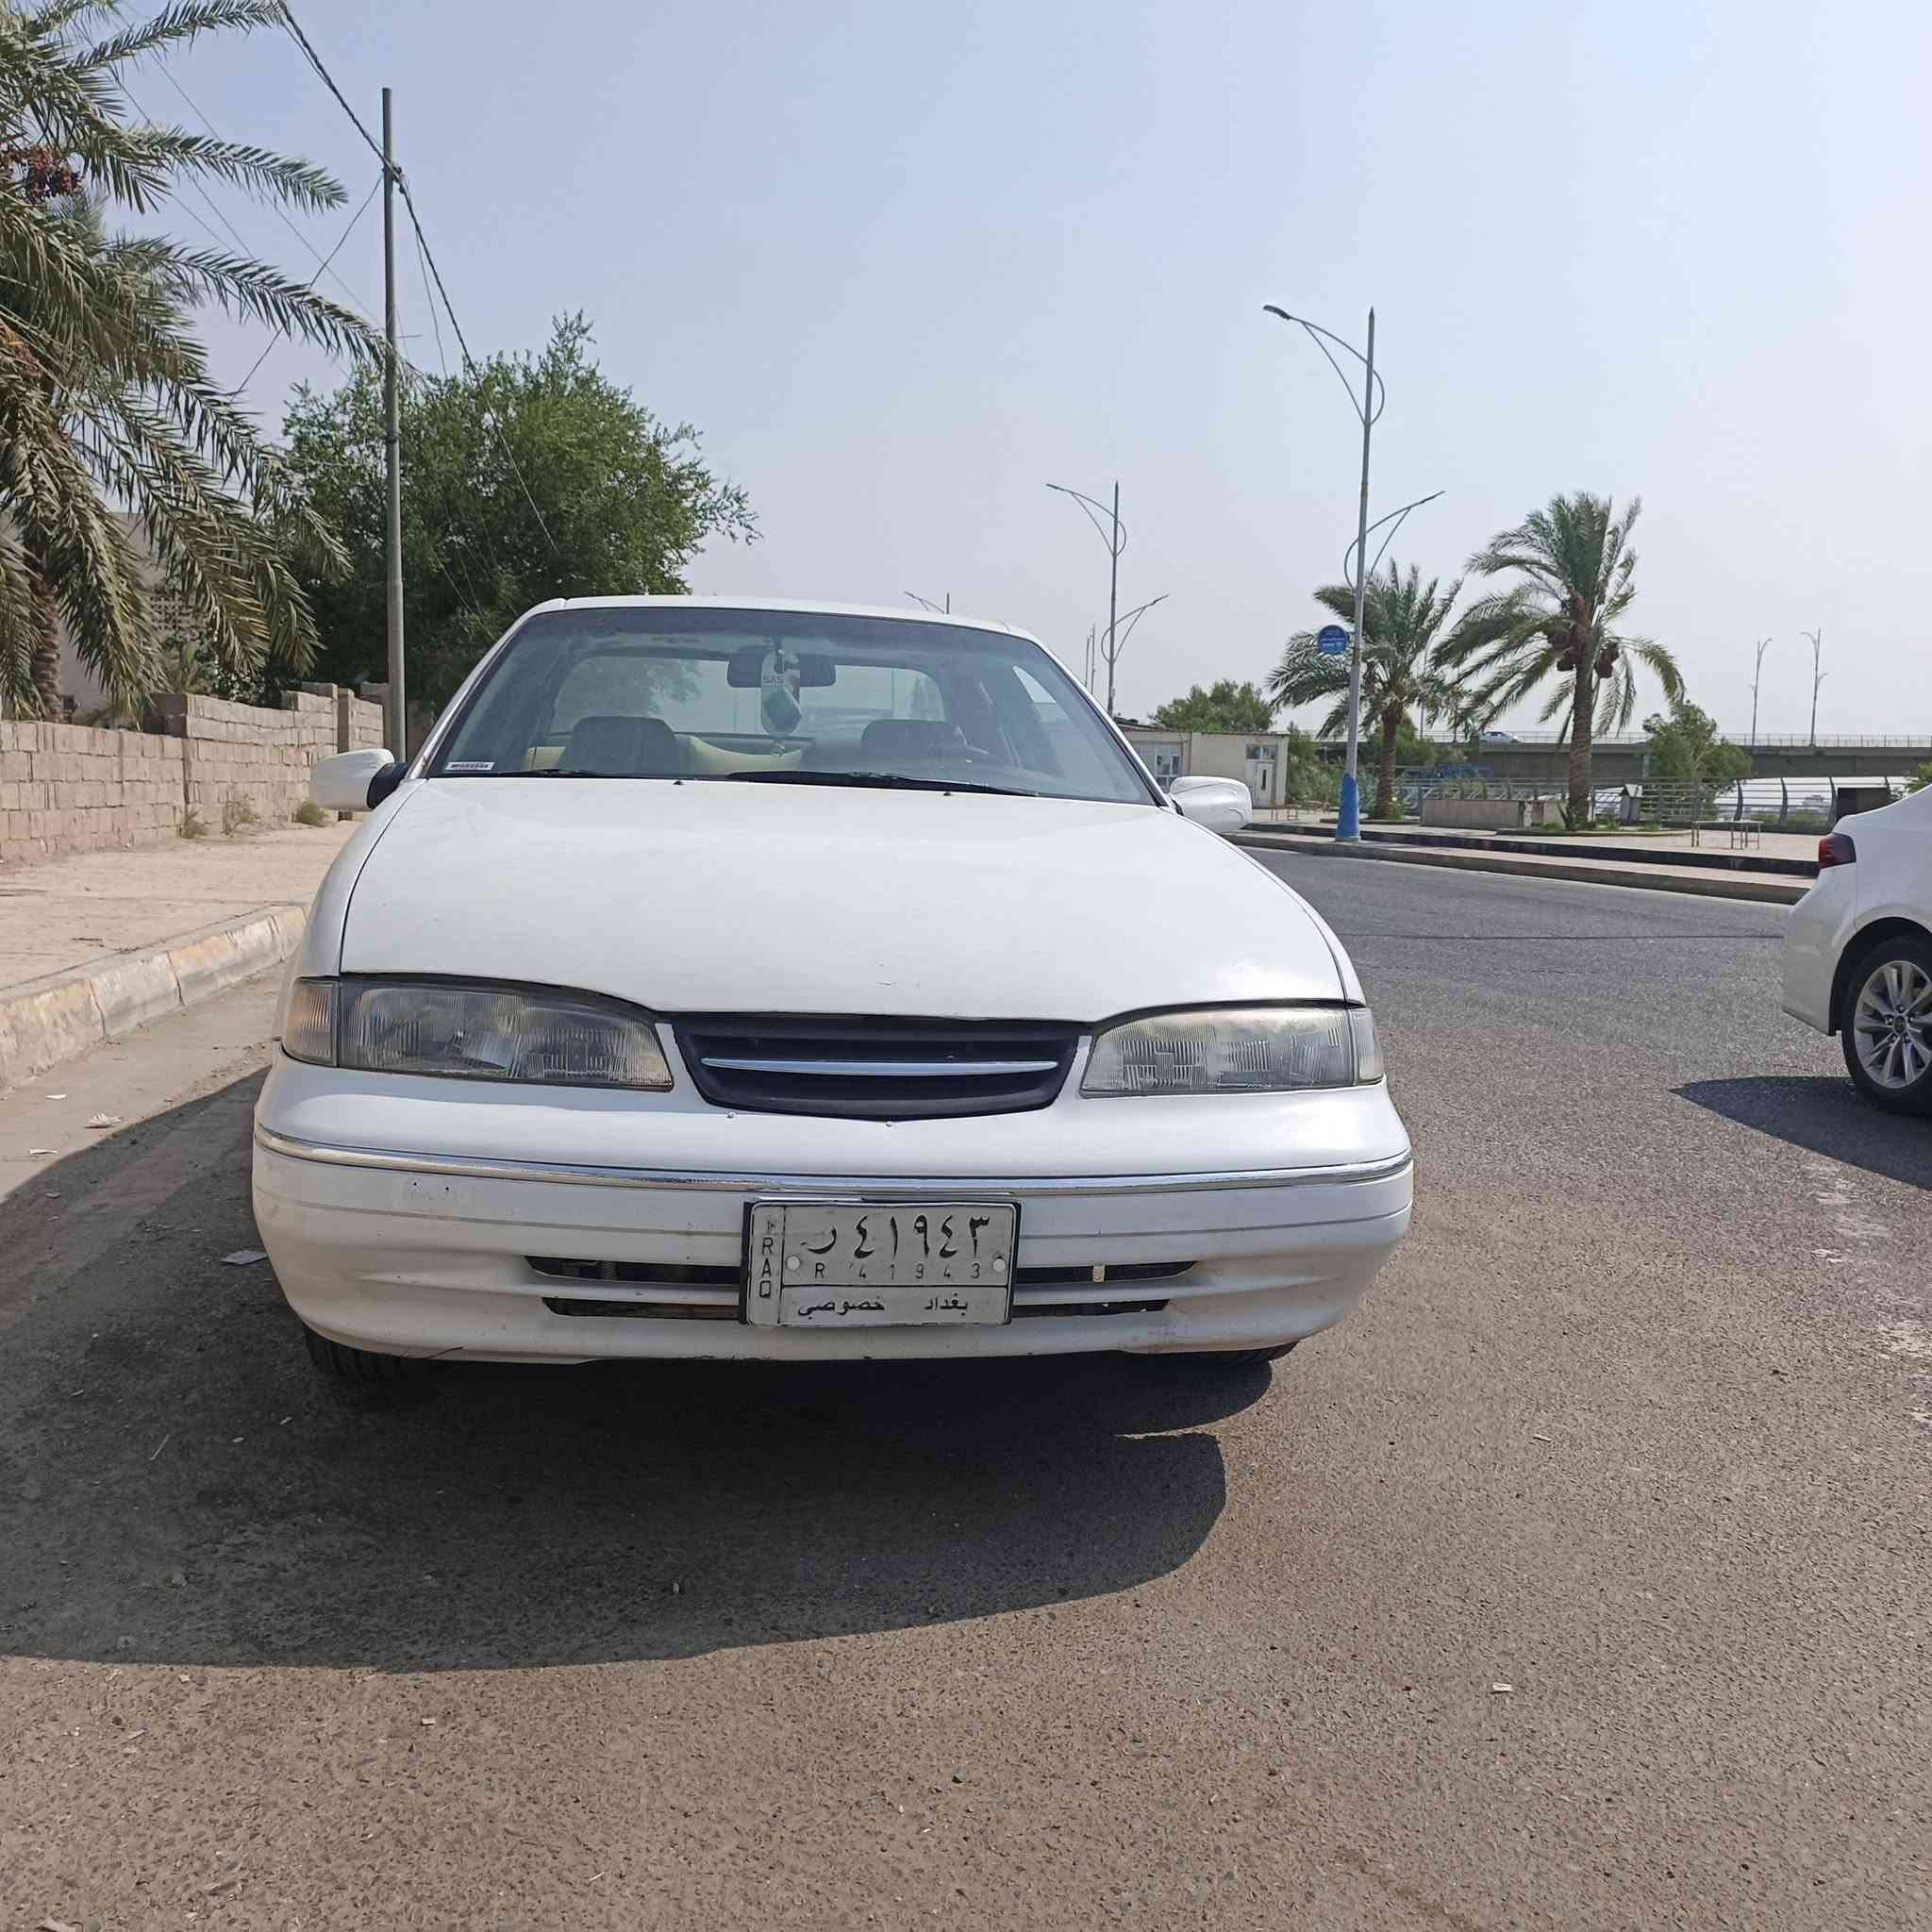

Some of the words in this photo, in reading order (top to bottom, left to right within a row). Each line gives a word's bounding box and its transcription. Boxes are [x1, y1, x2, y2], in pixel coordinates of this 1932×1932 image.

[814, 1262, 825, 1279] R
[798, 1295, 885, 1320] خصوصي
[924, 1292, 969, 1316] بغداد
